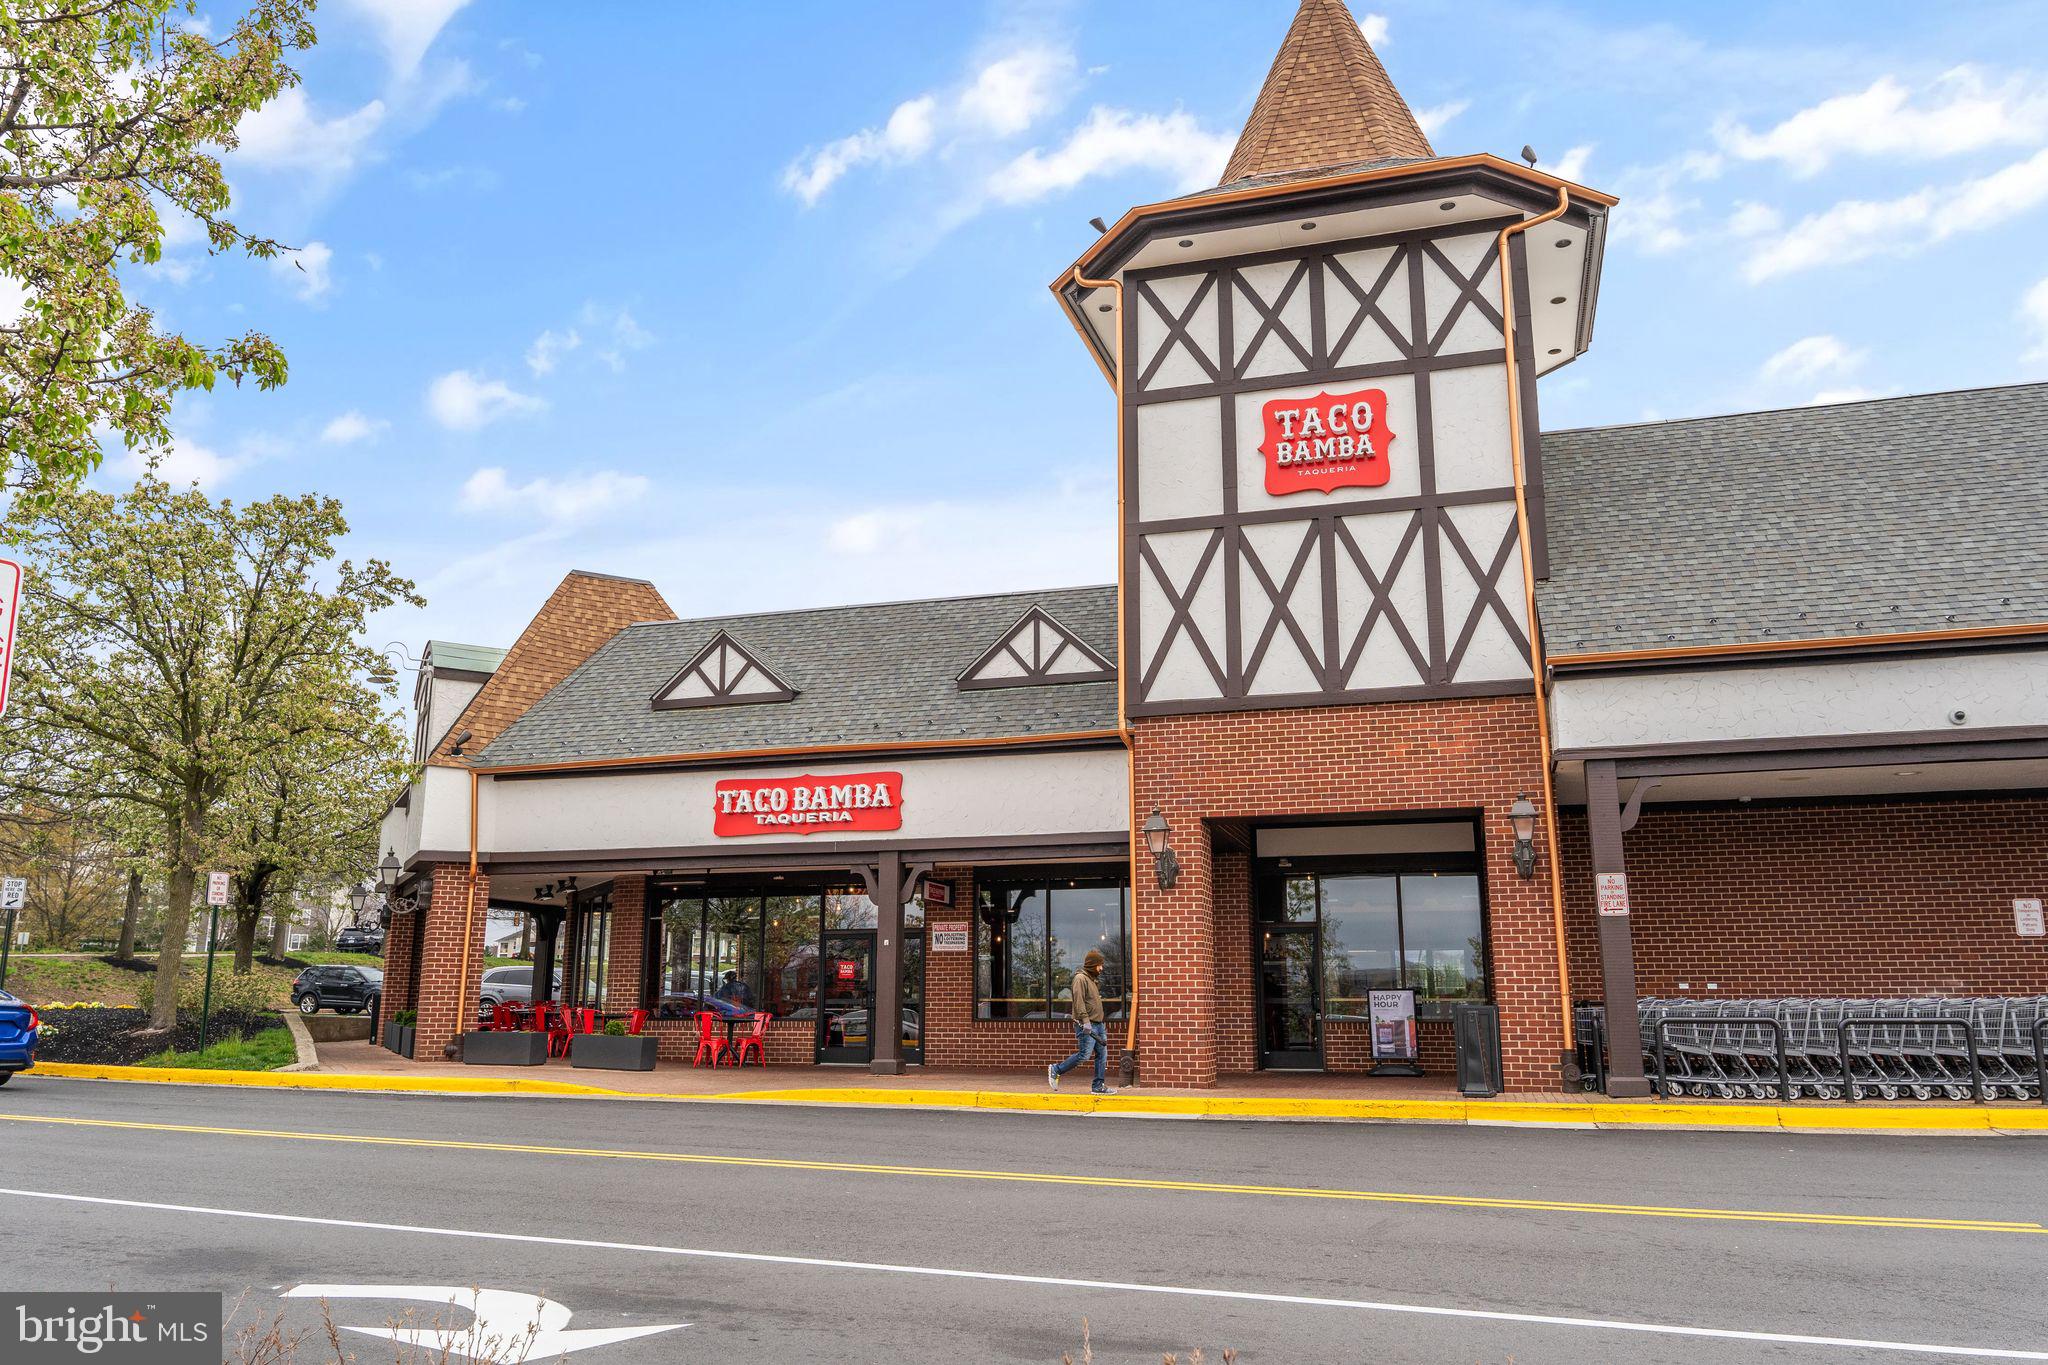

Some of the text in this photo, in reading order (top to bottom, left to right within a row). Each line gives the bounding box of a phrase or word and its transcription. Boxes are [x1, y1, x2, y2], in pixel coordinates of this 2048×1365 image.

[1274, 402, 1374, 440] TACO
[1276, 434, 1376, 466] BAMBA
[1298, 466, 1357, 477] TAQUERIA
[717, 783, 893, 814] TACO BAMBA
[754, 811, 853, 825] TAQUERIA
[934, 933, 943, 945] NO
